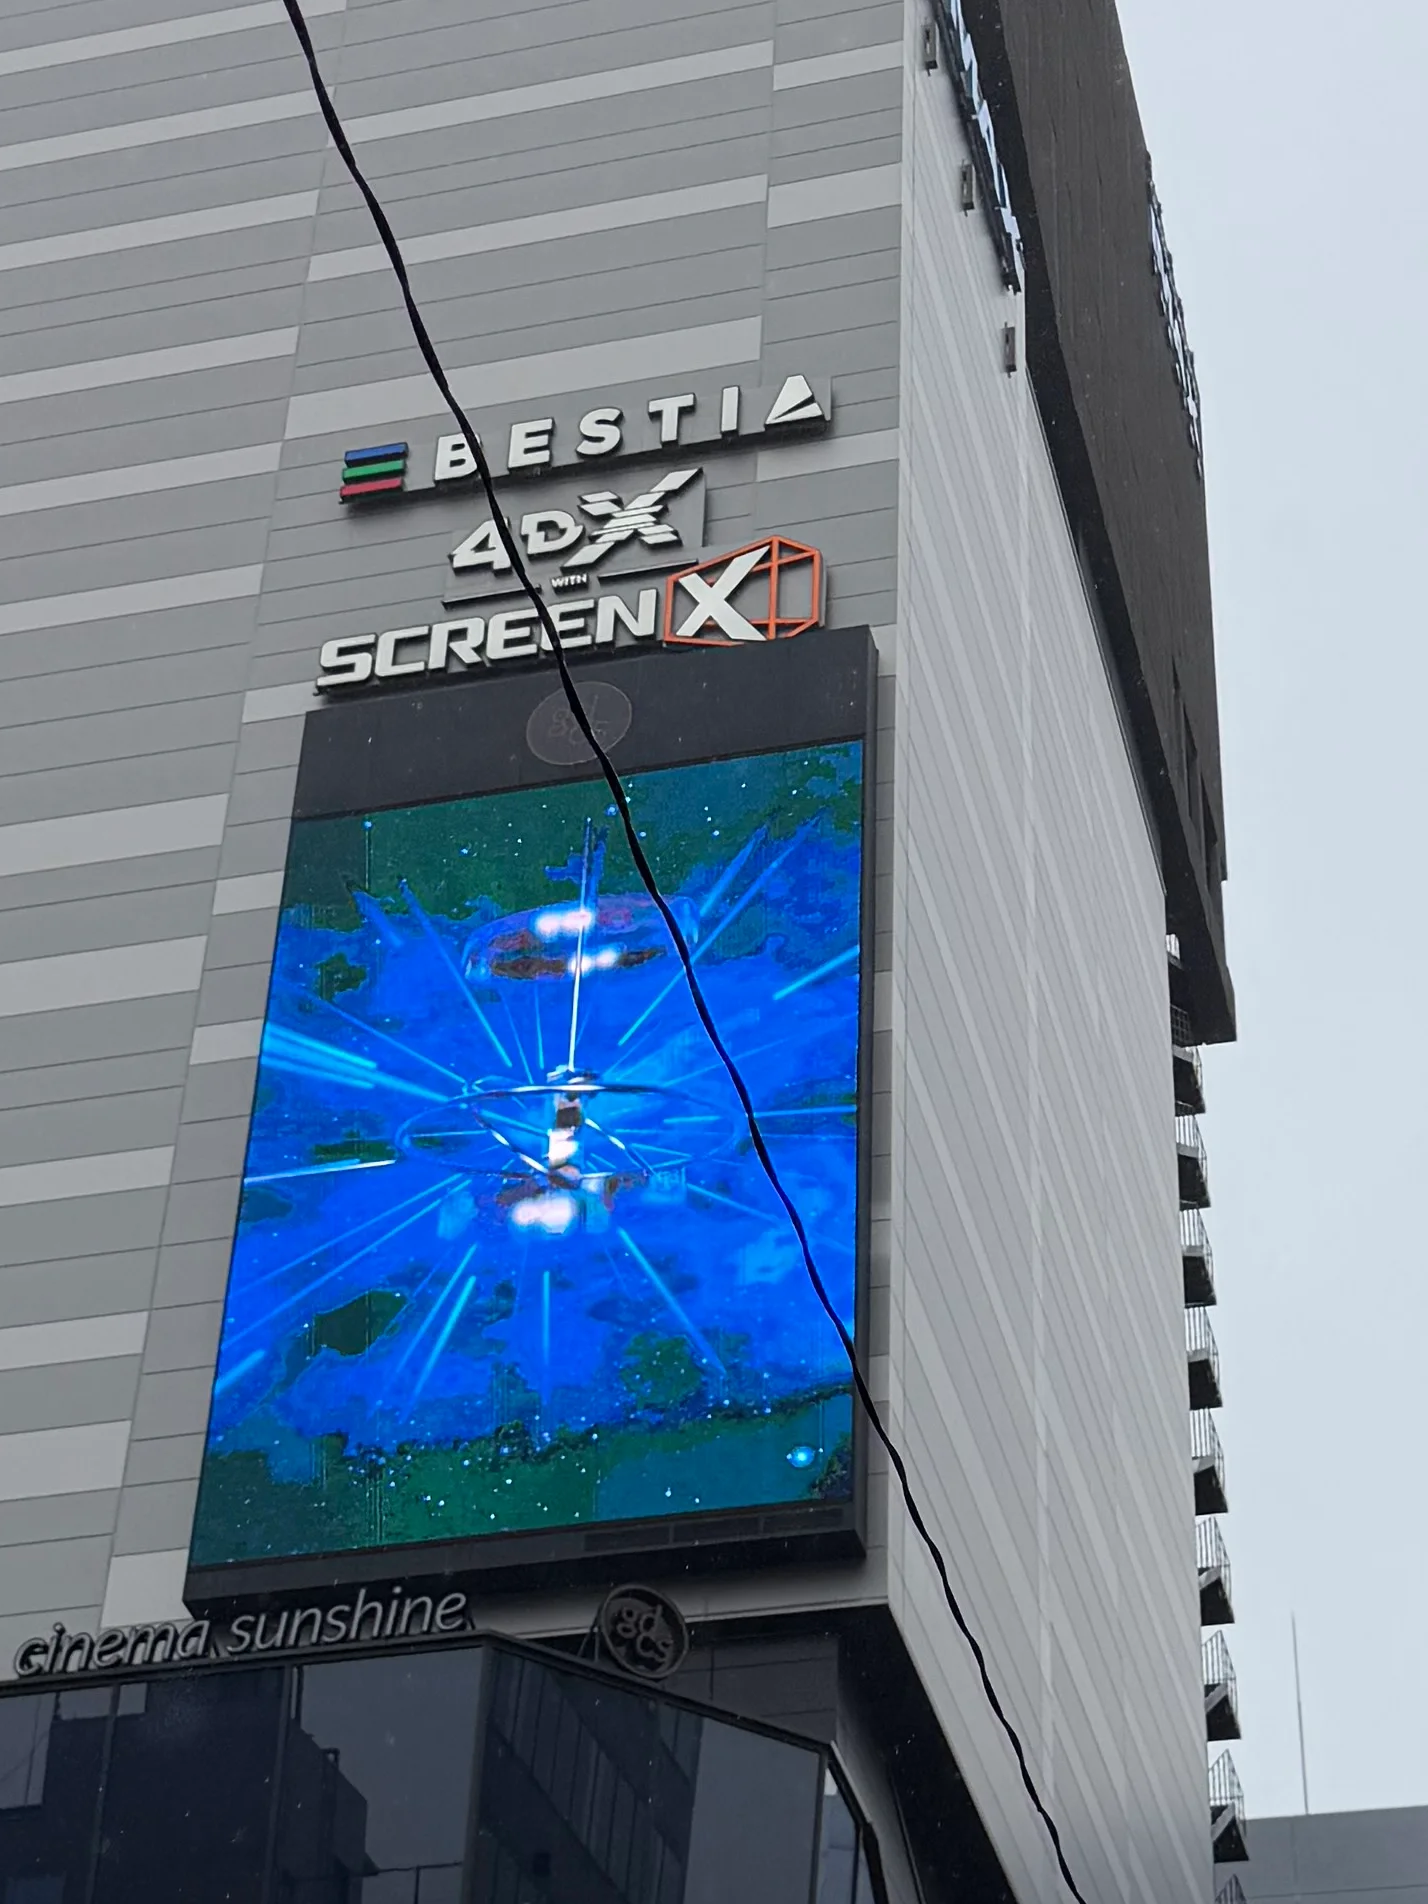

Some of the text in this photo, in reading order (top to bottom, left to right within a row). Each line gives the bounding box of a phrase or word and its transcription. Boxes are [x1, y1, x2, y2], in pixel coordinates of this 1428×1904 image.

[433, 373, 828, 483] BESTIA
[447, 466, 703, 573] 4DX
[550, 572, 589, 591] WITH
[10, 1585, 470, 1680] cinema sunshine
